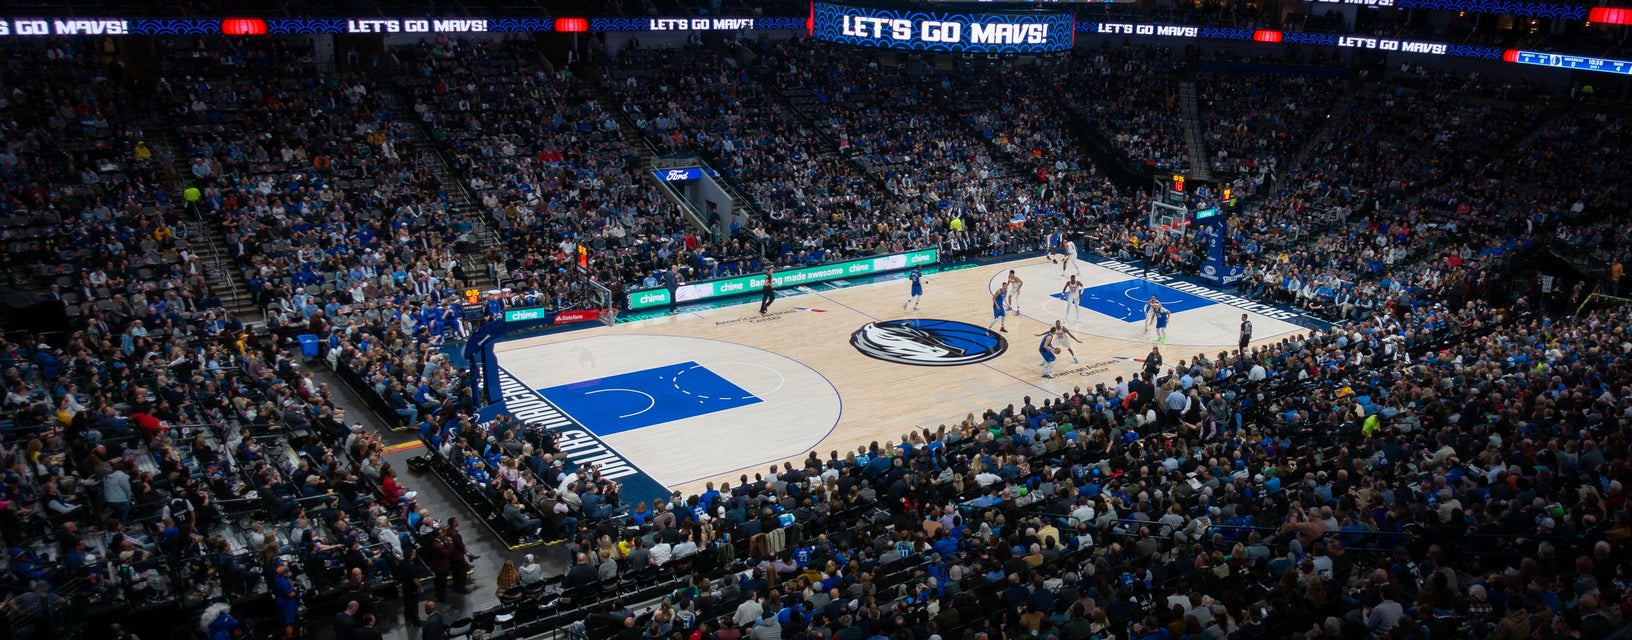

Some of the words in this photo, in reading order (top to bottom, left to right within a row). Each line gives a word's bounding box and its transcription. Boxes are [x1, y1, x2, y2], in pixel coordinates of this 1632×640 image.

[15, 20, 49, 34] GO
[54, 20, 128, 34] MAVS!
[348, 20, 400, 32] LET'S
[404, 20, 429, 32] GO
[433, 20, 488, 32] MAVS!
[650, 18, 688, 30] LET'S
[692, 19, 710, 30] GO
[843, 15, 912, 40] LET'S
[921, 20, 961, 43] GO
[970, 22, 1049, 44] MAVS!
[1098, 23, 1132, 34] LET'S
[1136, 25, 1154, 35] GO
[1157, 26, 1198, 37] MAVS!
[1338, 36, 1376, 48] LET'S
[1380, 40, 1398, 50] GO
[1402, 42, 1447, 54] MAVS!
[666, 170, 688, 180] Ford
[912, 254, 930, 263] chime
[720, 282, 743, 292] chime
[784, 273, 806, 283] made
[808, 268, 843, 278] awesome
[849, 264, 868, 272] chime
[640, 293, 665, 304] chime
[512, 311, 538, 320] chime
